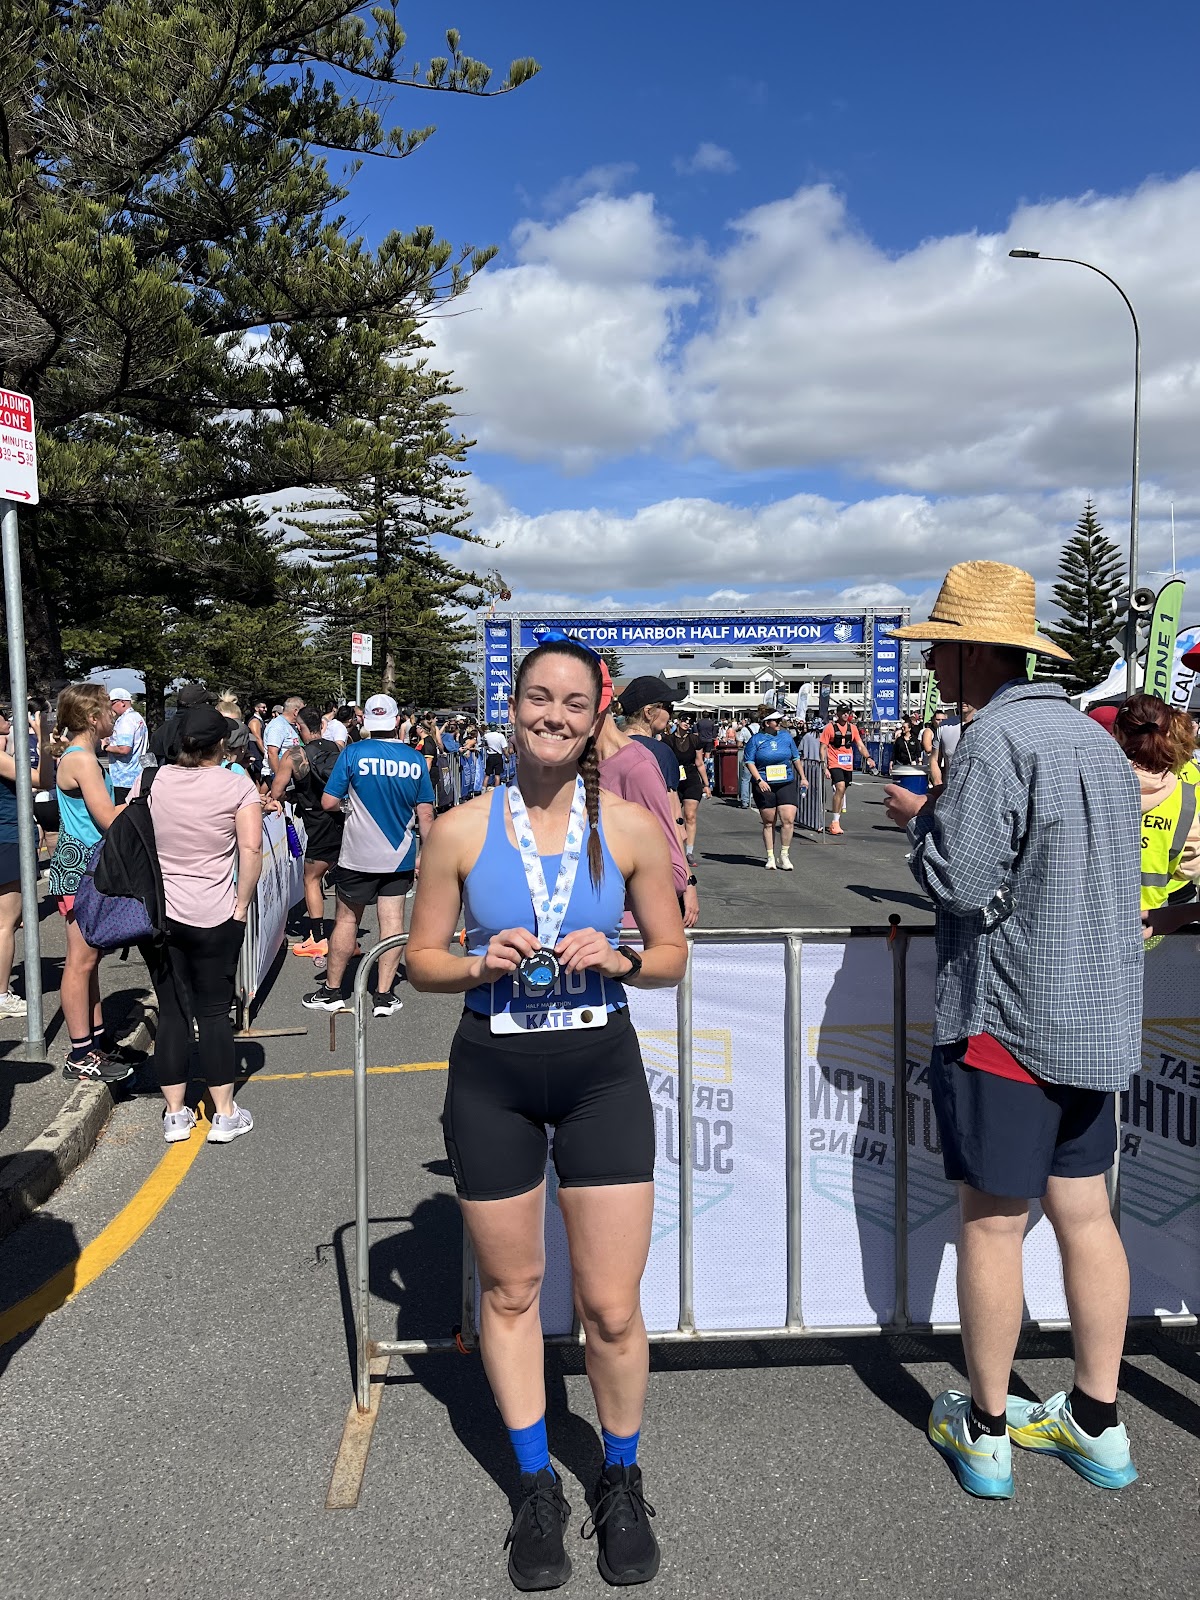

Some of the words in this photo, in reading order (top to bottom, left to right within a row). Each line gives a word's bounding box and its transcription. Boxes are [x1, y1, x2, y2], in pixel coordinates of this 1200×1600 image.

[2, 434, 33, 451] MINUTES
[562, 627, 618, 640] VICTOR
[622, 627, 686, 640] HARBOR
[691, 626, 730, 639] HALF
[734, 625, 821, 639] MARATHON
[877, 665, 895, 673] frosti
[1170, 670, 1196, 708] ICAL
[358, 757, 421, 780] STIDDO
[526, 1011, 573, 1029] KATE
